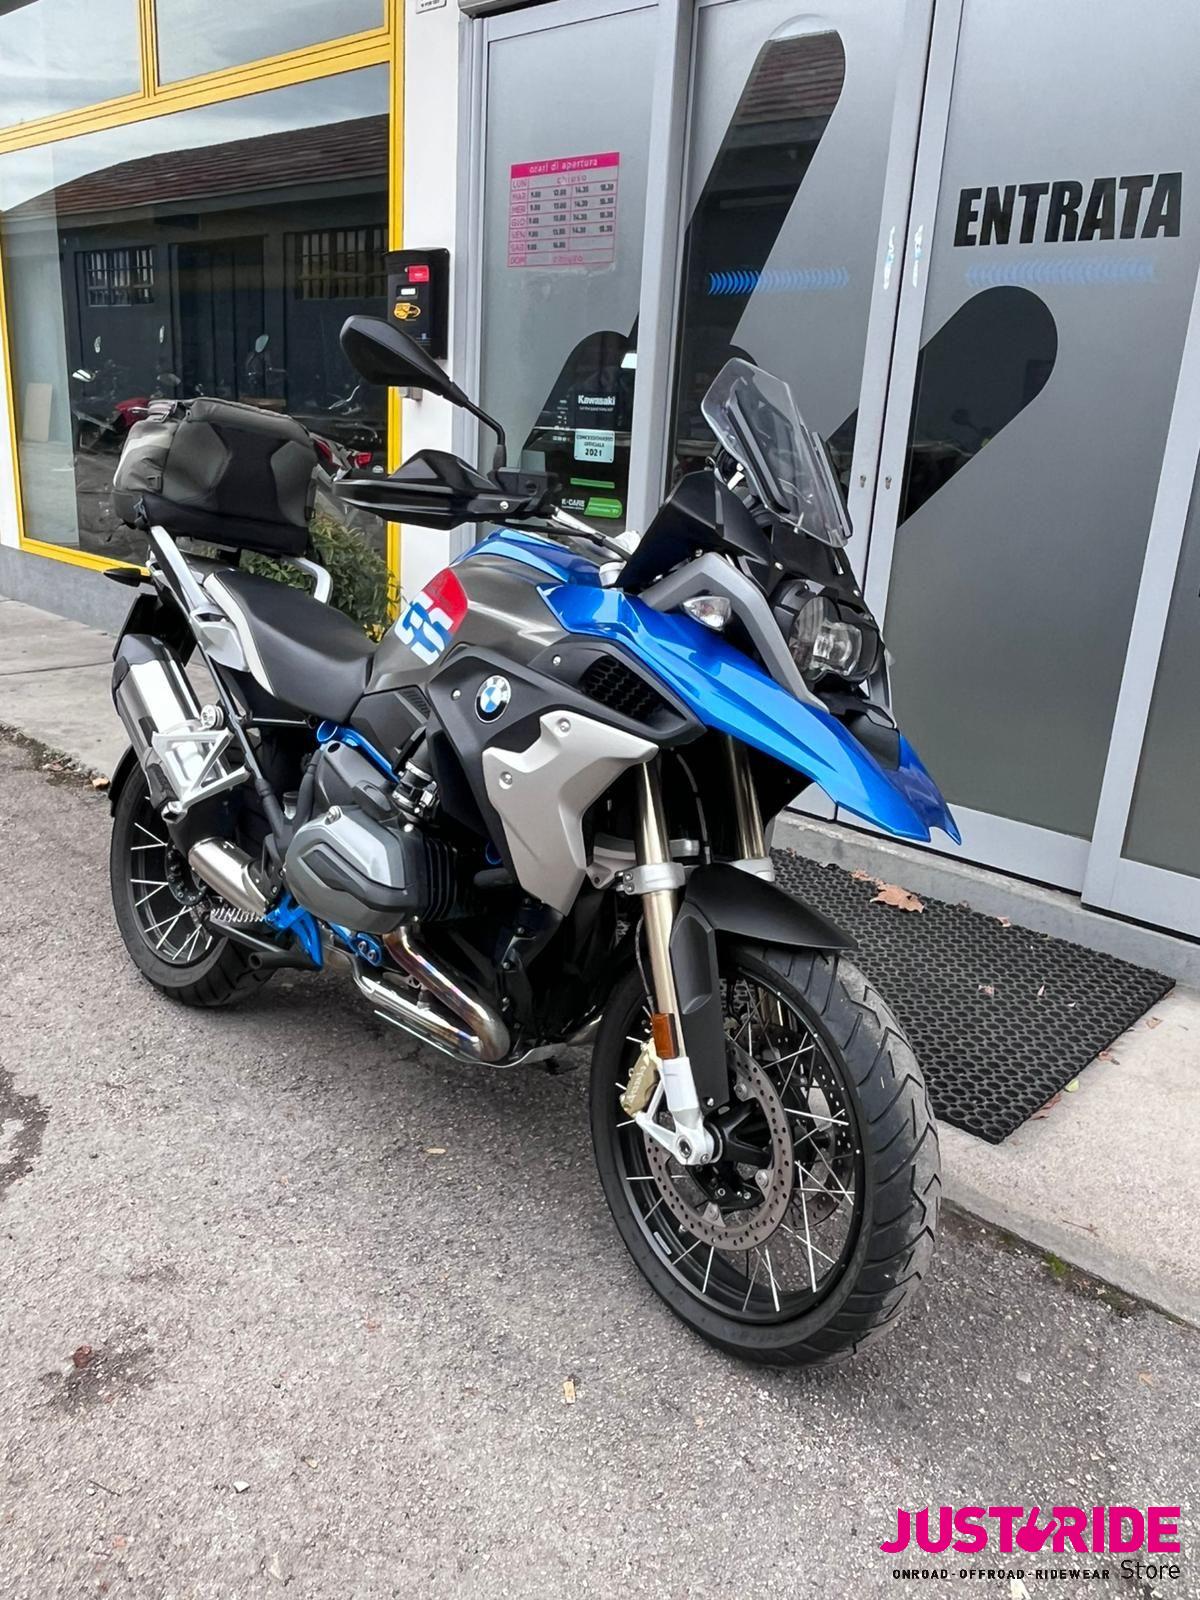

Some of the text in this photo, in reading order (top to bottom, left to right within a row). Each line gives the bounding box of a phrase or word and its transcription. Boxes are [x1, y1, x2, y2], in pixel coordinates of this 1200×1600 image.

[551, 162, 560, 171] di
[562, 159, 598, 170] apertura
[953, 171, 1183, 247] ENTRATA
[578, 395, 616, 406] Kawasaki
[585, 448, 603, 457] 2021
